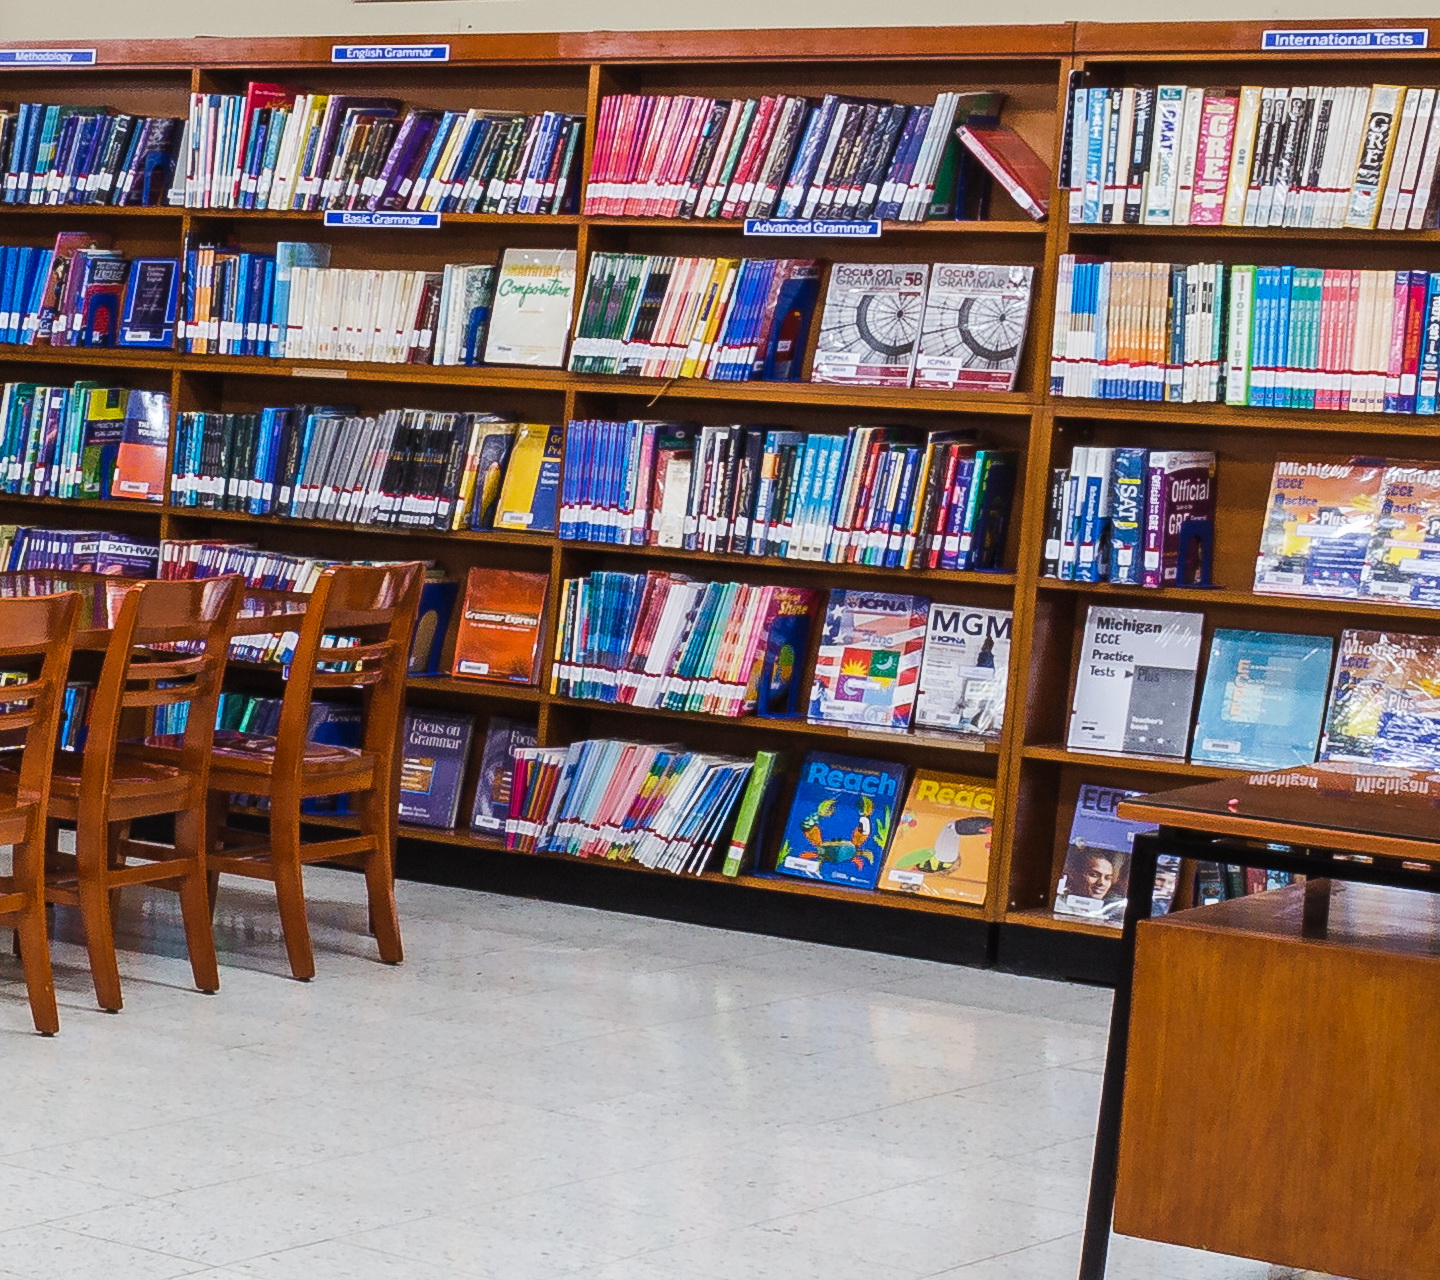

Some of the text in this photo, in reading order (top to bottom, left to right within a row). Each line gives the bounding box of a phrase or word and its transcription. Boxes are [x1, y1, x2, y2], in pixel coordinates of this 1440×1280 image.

[1275, 34, 1414, 46] International Tests
[15, 50, 74, 63] Methodology
[346, 46, 434, 61] English Grammar
[1158, 109, 1177, 152] GMAT
[1203, 115, 1230, 182] GRE
[1363, 113, 1393, 168] GRE
[343, 212, 423, 226] Basic Grammar
[752, 221, 872, 235] Advanced Grammar
[836, 265, 894, 277] Focus on
[836, 272, 924, 287] GRAMMAR 5B
[937, 276, 1005, 288] GRAMMAR
[498, 278, 571, 308] Composition
[1171, 478, 1210, 502] Official
[1118, 484, 1138, 522] SAT
[1320, 511, 1348, 526] Plus
[858, 597, 909, 613] ICPNA
[465, 609, 538, 626] Grammar Express
[931, 609, 1013, 639] MGM
[1096, 616, 1163, 634] Michigan
[1094, 632, 1122, 646] ECCE
[1091, 649, 1134, 664] Practice
[1090, 665, 1160, 683] Tests Plus
[1388, 694, 1416, 710] Plus
[412, 718, 461, 737] Focus on
[409, 730, 462, 751] Grammar
[807, 761, 897, 797] Reach
